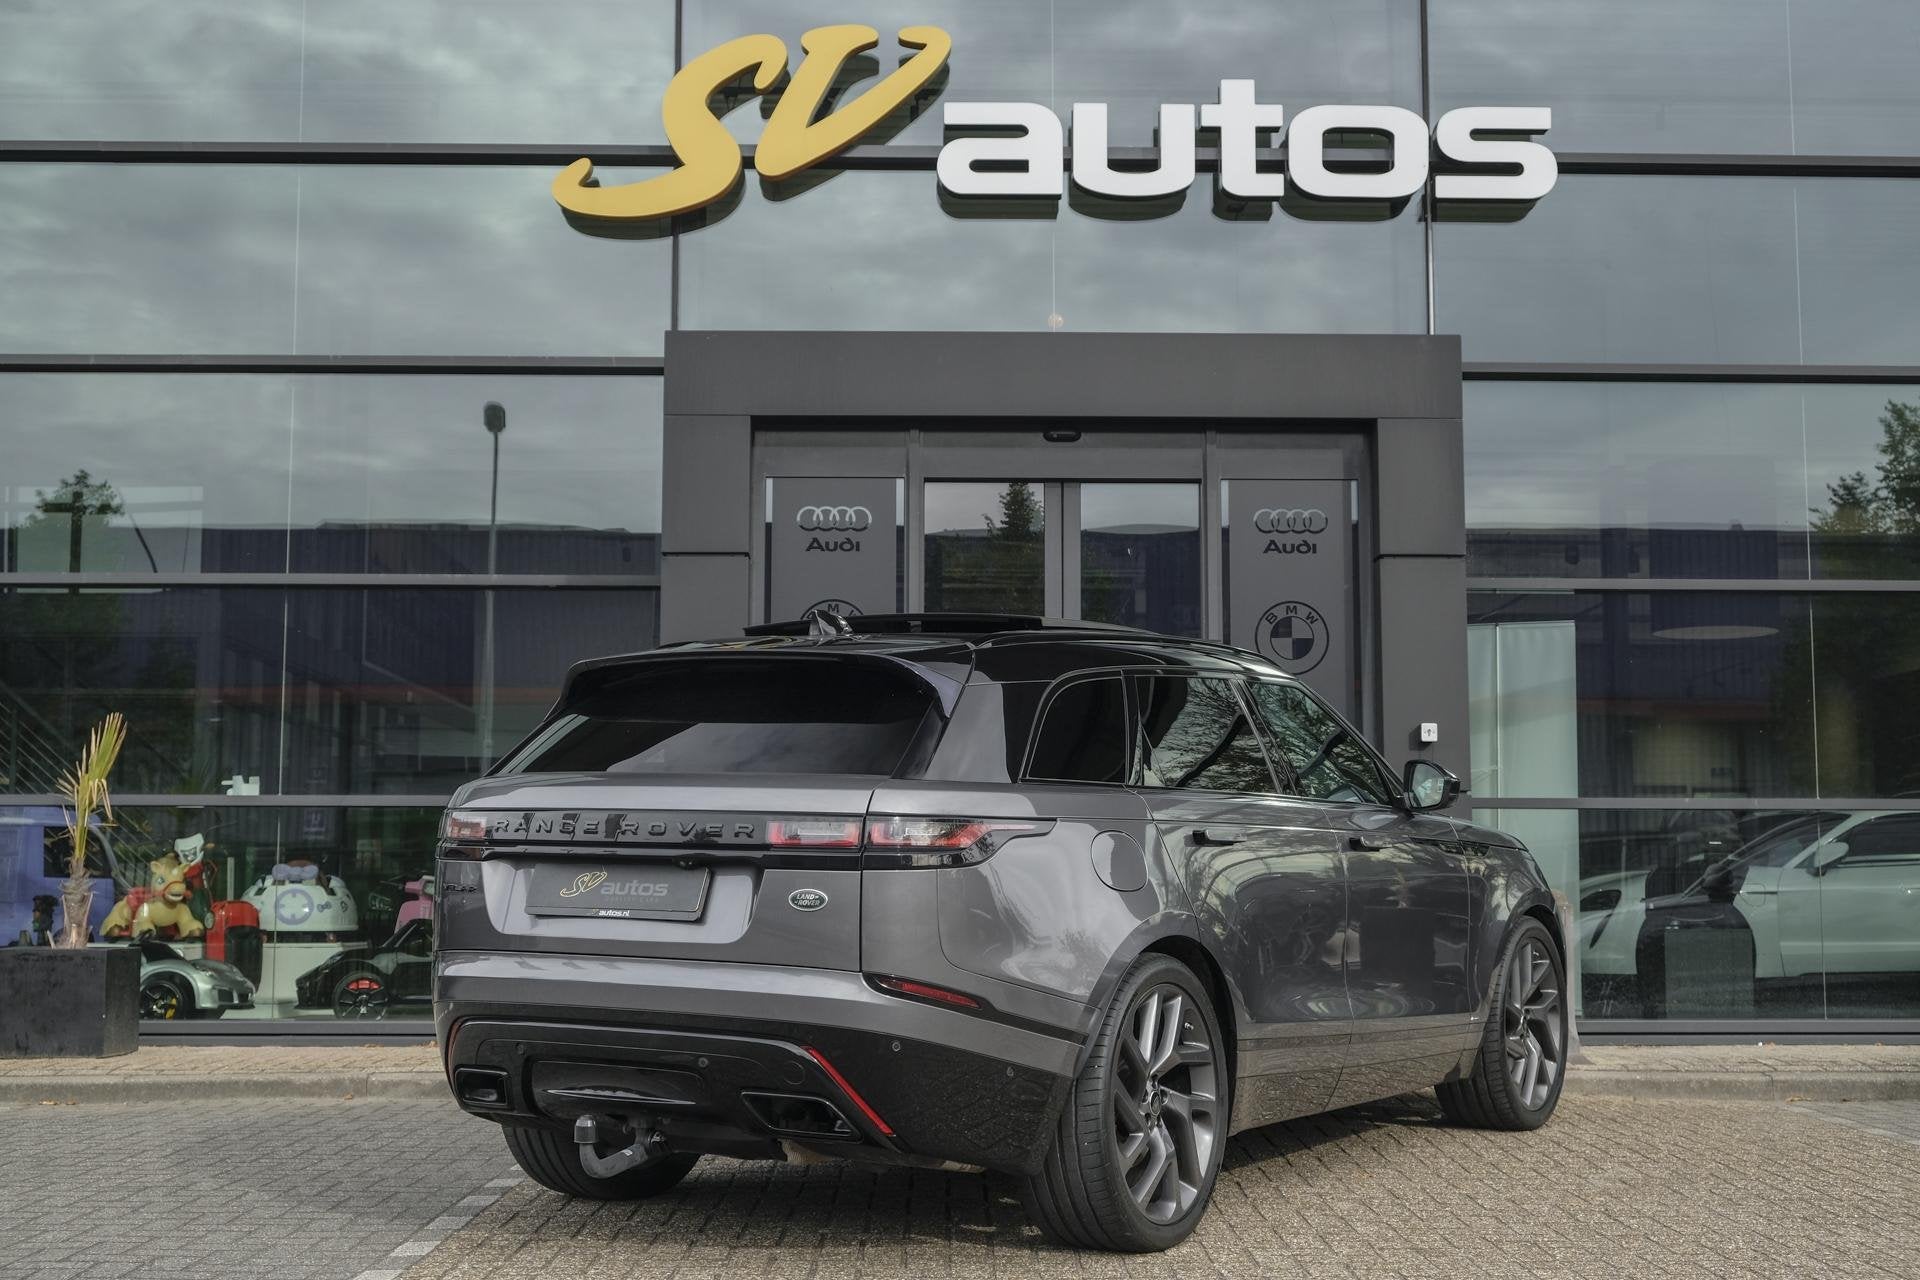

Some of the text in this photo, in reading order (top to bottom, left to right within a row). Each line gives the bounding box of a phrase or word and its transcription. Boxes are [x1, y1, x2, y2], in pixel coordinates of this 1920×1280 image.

[551, 24, 1558, 218] SV autos
[805, 537, 860, 551] Audi
[1263, 540, 1317, 554] Audi
[1265, 605, 1318, 625] BMW
[495, 820, 755, 838] RANGE ROVER
[560, 871, 669, 897] SV autos
